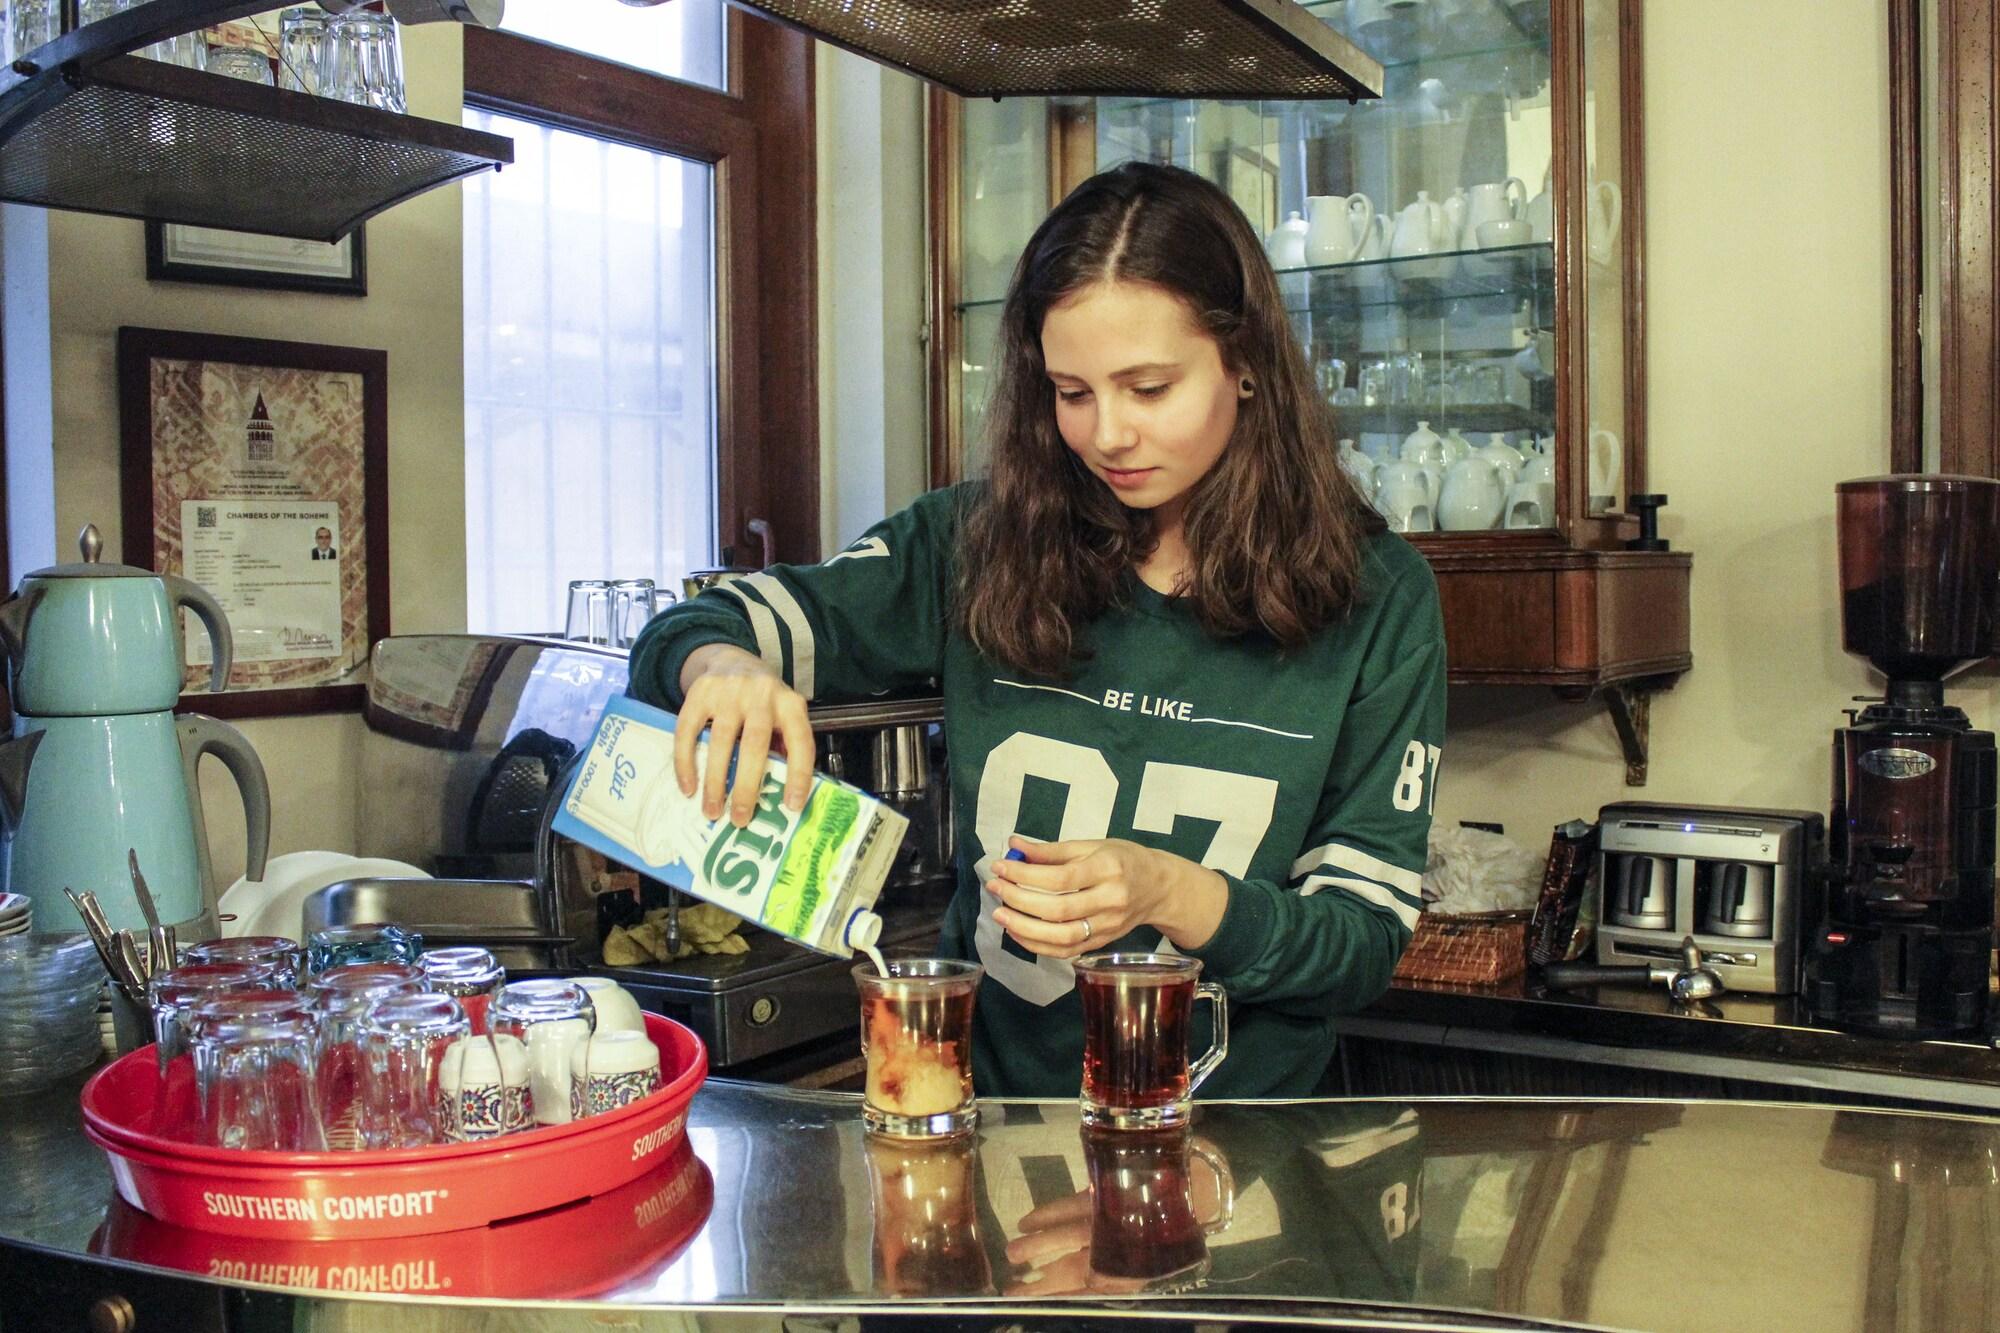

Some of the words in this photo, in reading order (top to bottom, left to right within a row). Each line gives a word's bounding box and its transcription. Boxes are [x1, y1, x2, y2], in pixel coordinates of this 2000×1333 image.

[1103, 689, 1134, 711] BE
[1140, 695, 1194, 721] LIKE
[581, 761, 598, 788] 1000
[609, 753, 636, 801] Süt
[1392, 740, 1442, 816] 87
[203, 1191, 318, 1221] SOUTHERN
